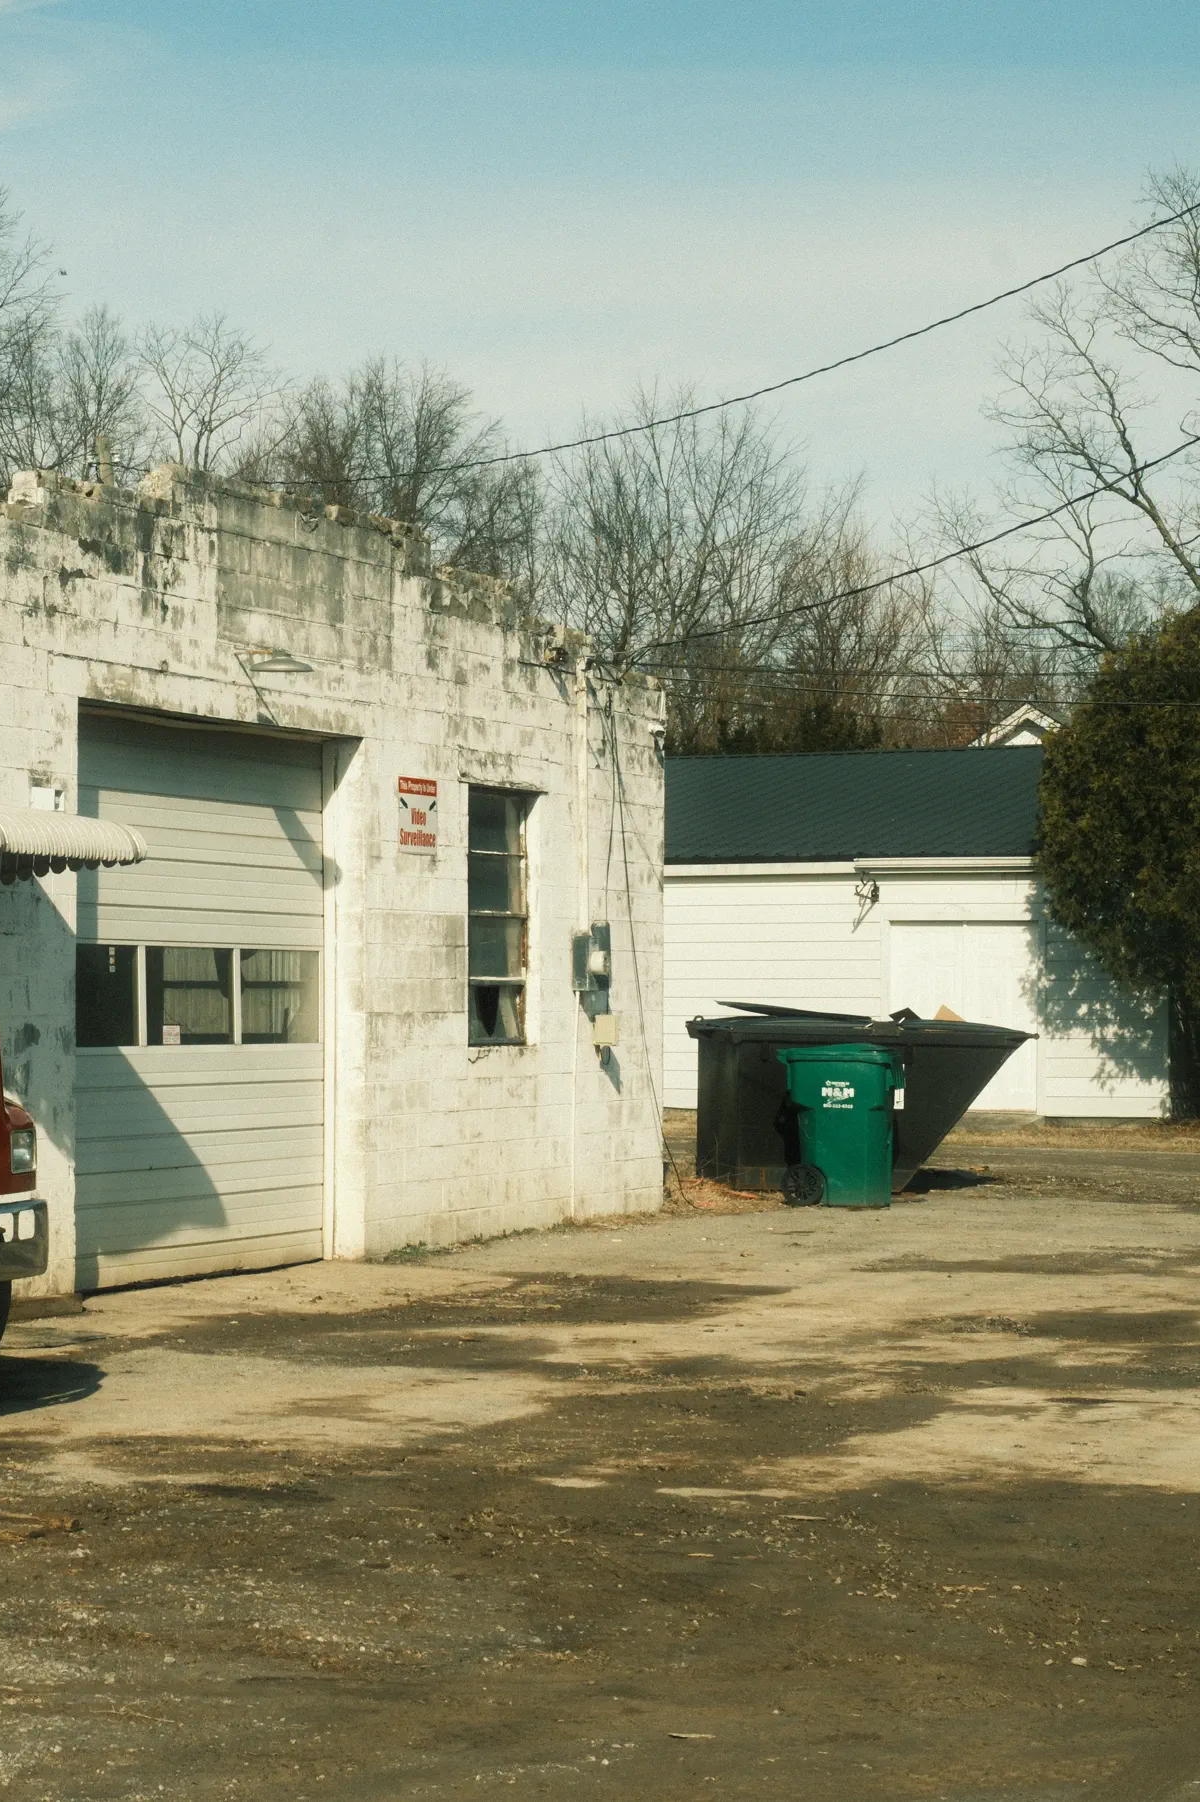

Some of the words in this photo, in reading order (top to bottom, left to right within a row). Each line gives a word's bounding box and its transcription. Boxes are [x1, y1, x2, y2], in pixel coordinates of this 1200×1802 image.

[408, 780, 422, 794] Property
[410, 807, 427, 826] Video
[399, 827, 436, 848] Surveillance
[821, 1087, 855, 1098] M&M
